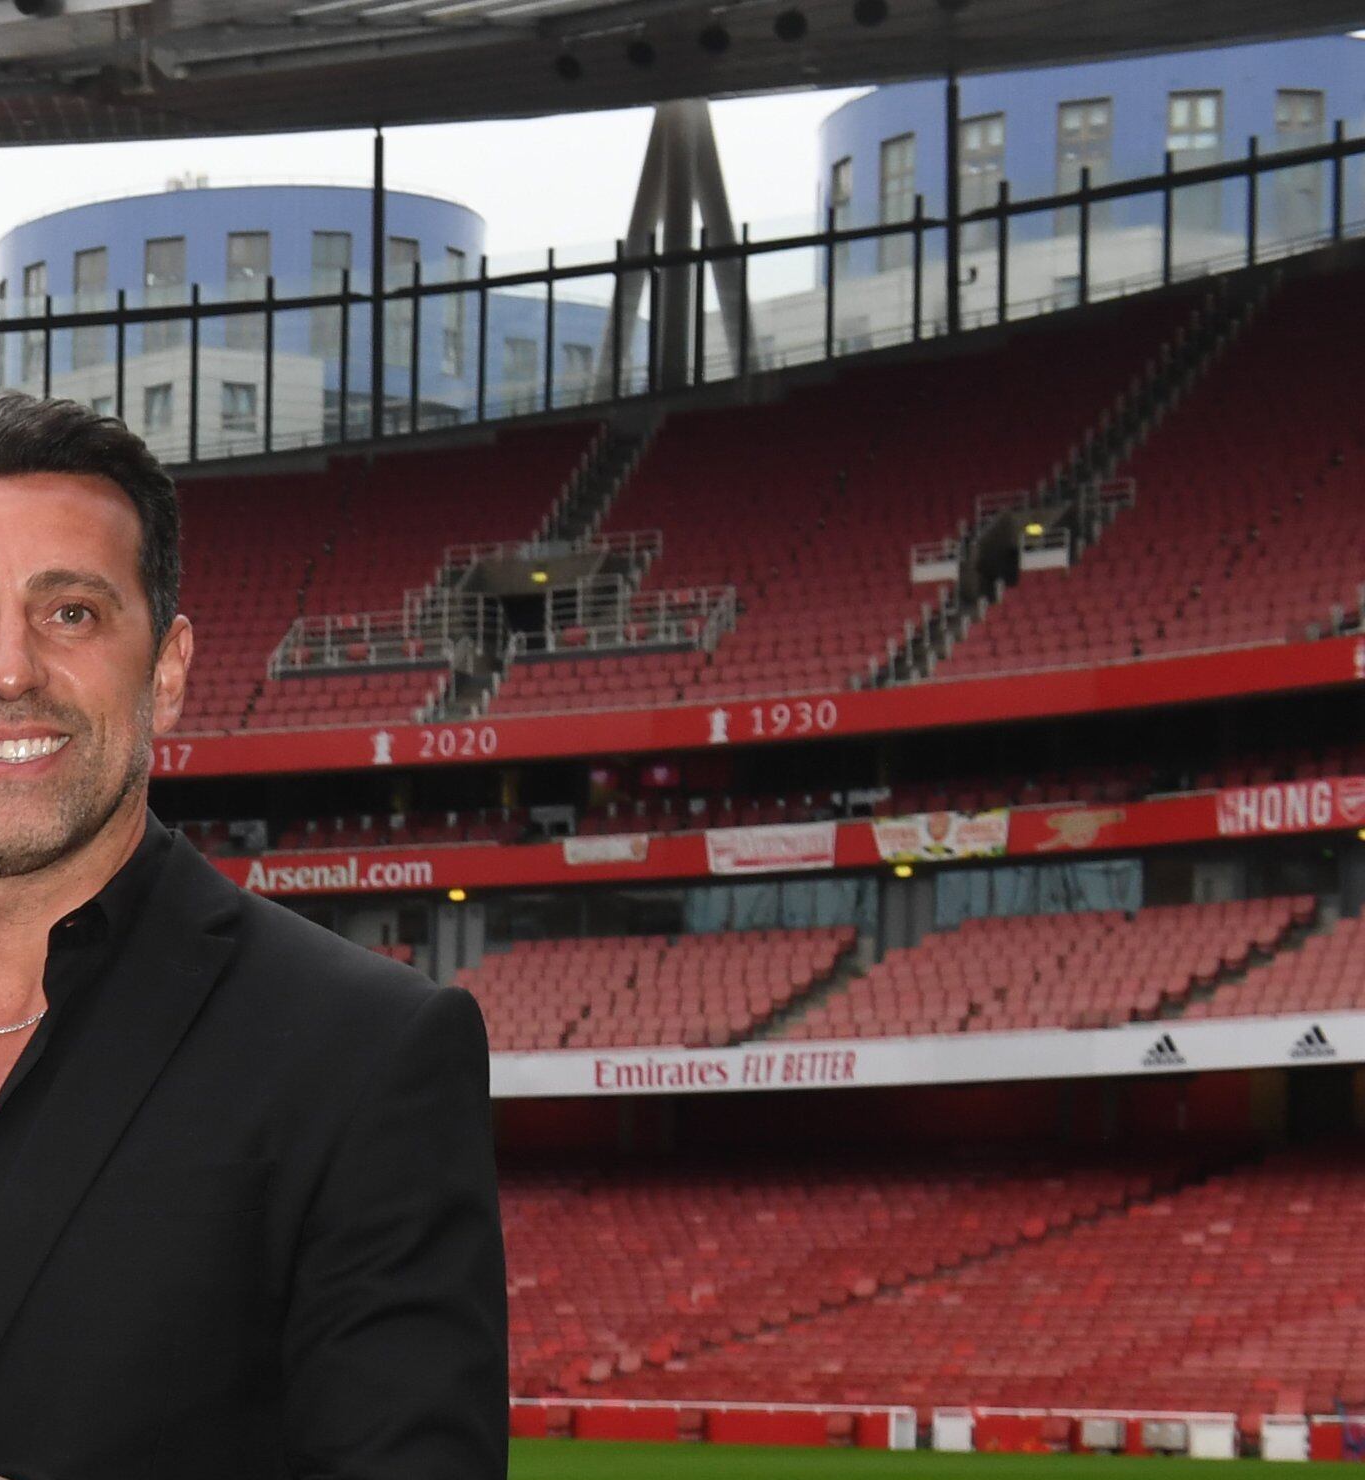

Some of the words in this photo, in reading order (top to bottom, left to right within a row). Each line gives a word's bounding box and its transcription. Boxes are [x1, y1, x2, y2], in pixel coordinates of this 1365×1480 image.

[751, 699, 838, 736] 1930
[419, 726, 498, 758] 2020
[1238, 780, 1333, 834] HONG
[244, 858, 434, 893] Arsenal.com
[594, 1056, 729, 1089] Emirates
[742, 1053, 776, 1084] FLY
[782, 1050, 857, 1082] BETTER
